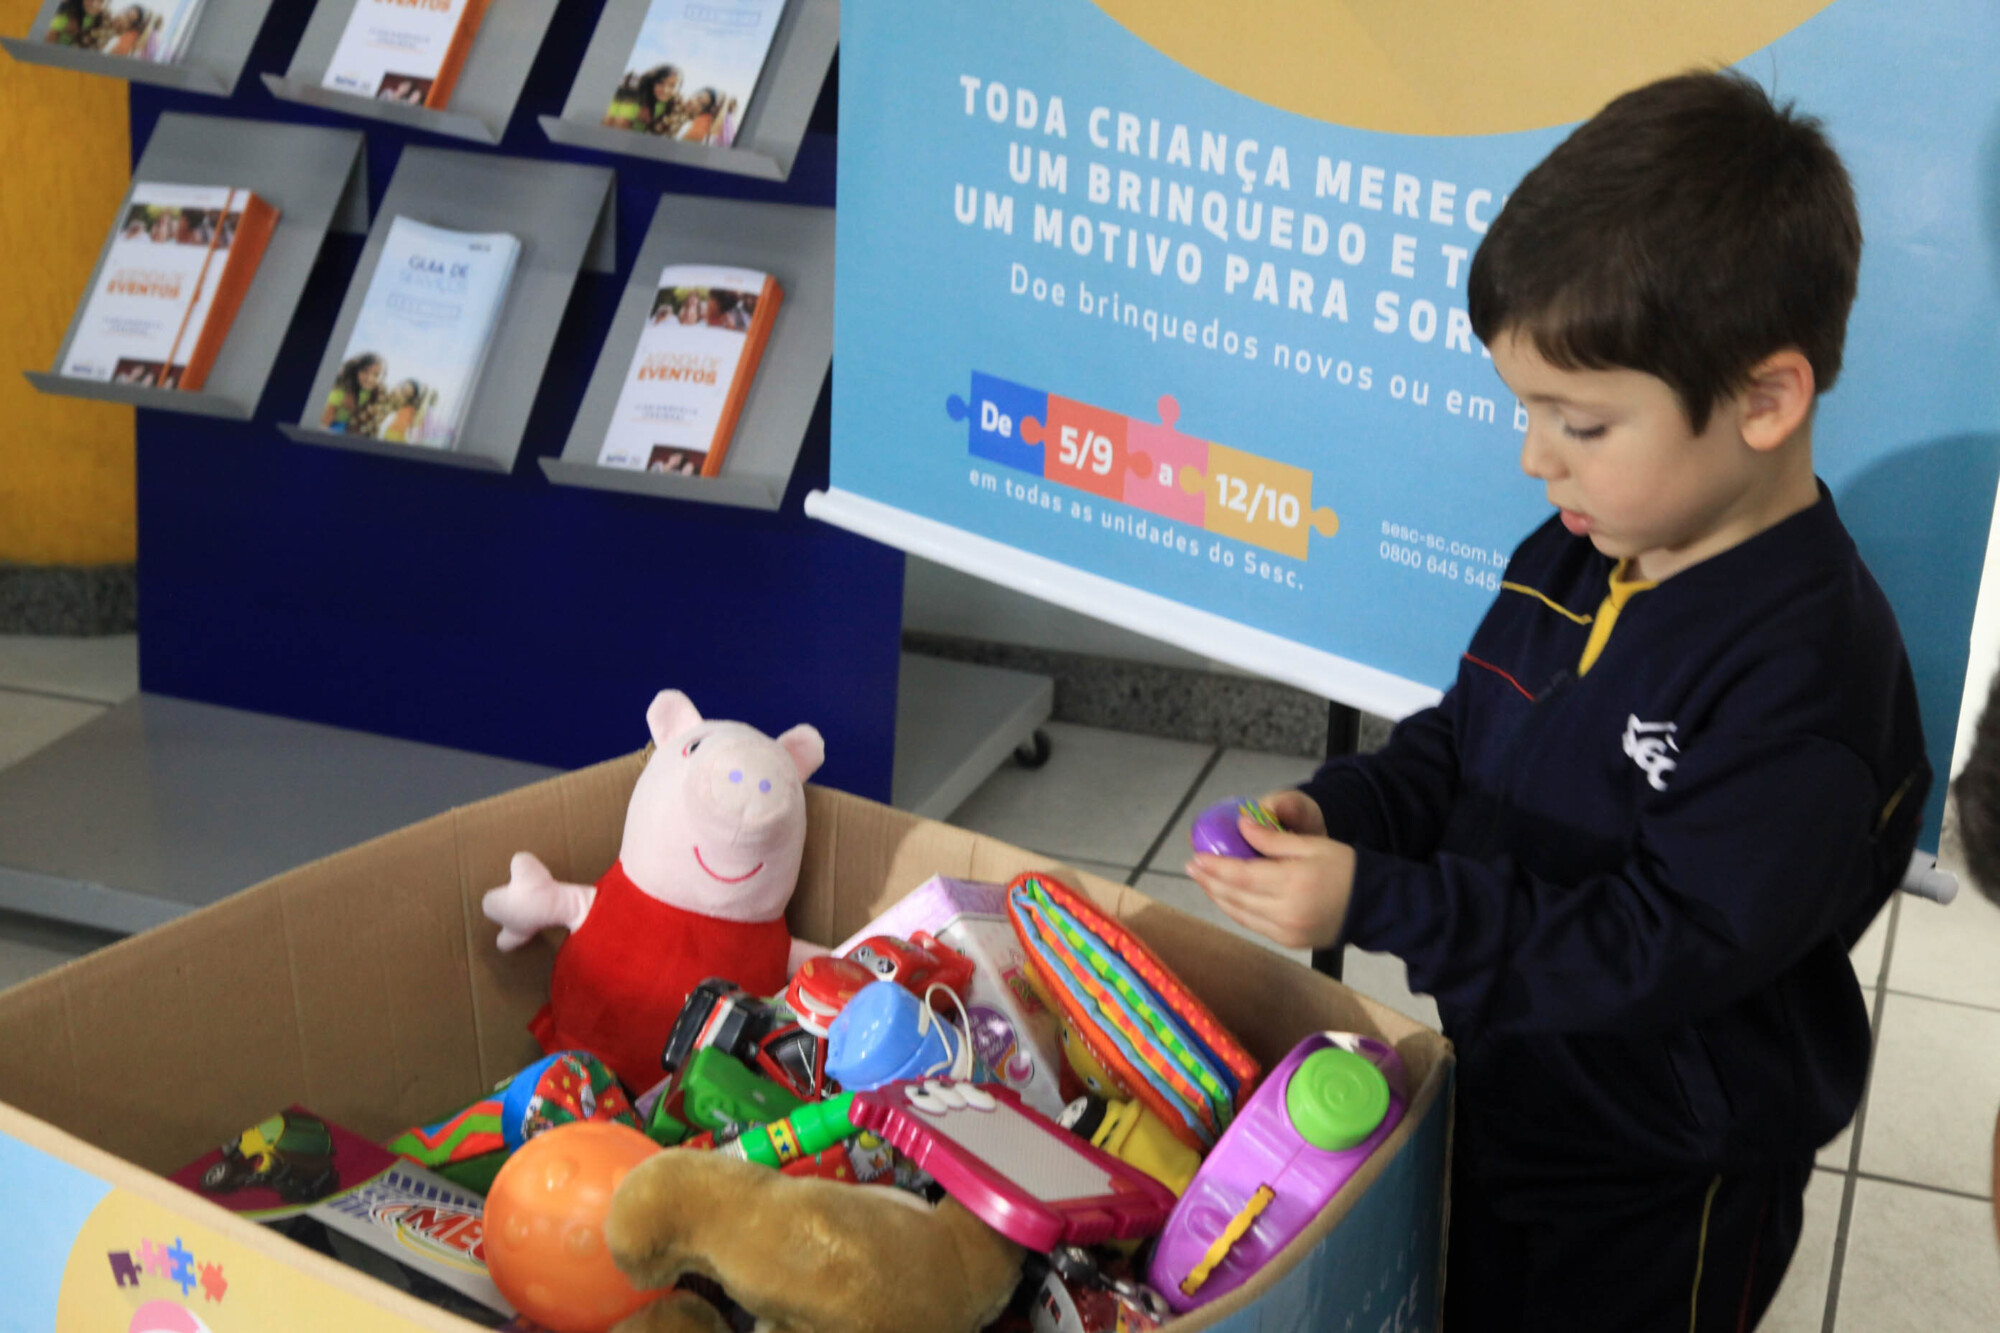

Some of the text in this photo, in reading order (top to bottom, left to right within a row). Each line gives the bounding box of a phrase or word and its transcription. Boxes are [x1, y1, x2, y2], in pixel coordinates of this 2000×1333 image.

[960, 75, 1508, 234] TODA CRIANÇA MEREC
[1009, 142, 1468, 289] UM BRINQUEDO E T
[955, 184, 1491, 359] UM MOTIVO PARA SOR
[638, 366, 717, 386] EVENTOS
[1011, 263, 1529, 433] Doe brinquedos novos ou em b
[970, 467, 1304, 591] em todas as unidades do Sesc.
[981, 401, 1301, 529] De 5/9 a 12/10
[1379, 540, 1422, 569] 0800
[1427, 554, 1458, 580] 645
